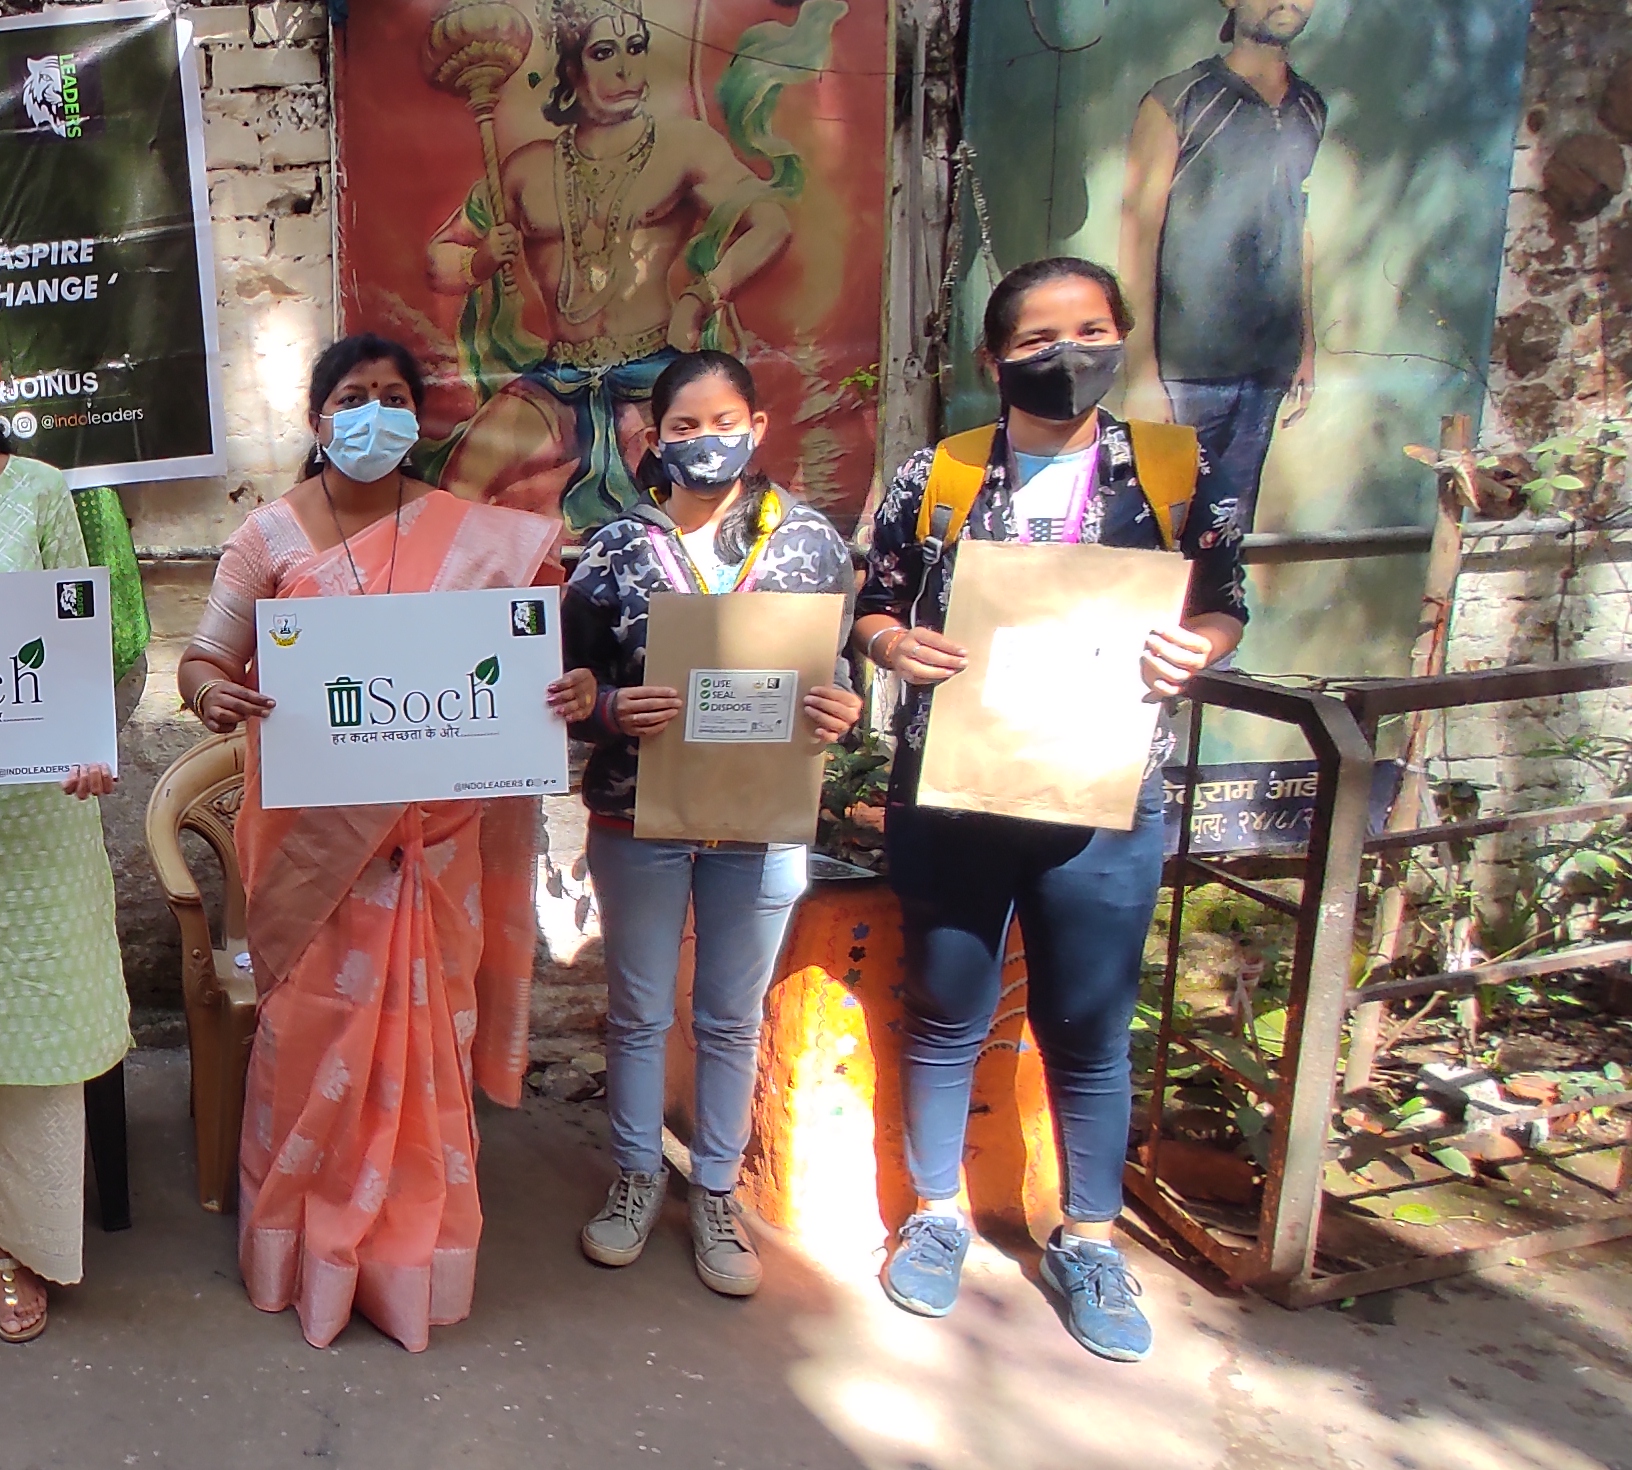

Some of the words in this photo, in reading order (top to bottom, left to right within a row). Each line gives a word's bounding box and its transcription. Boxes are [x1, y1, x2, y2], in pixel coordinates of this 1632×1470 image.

[59, 53, 82, 138] LEADERS
[41, 407, 144, 430] @indoleaders
[713, 679, 732, 688] USE
[368, 671, 499, 725] Soch
[712, 691, 736, 699] SEAL
[711, 703, 752, 712] DISPOSE
[331, 733, 347, 745] हर
[350, 731, 378, 743] कदम
[381, 729, 422, 742] स्वच्छता
[425, 724, 436, 739] के
[453, 779, 523, 792] @INDOLEADERS
